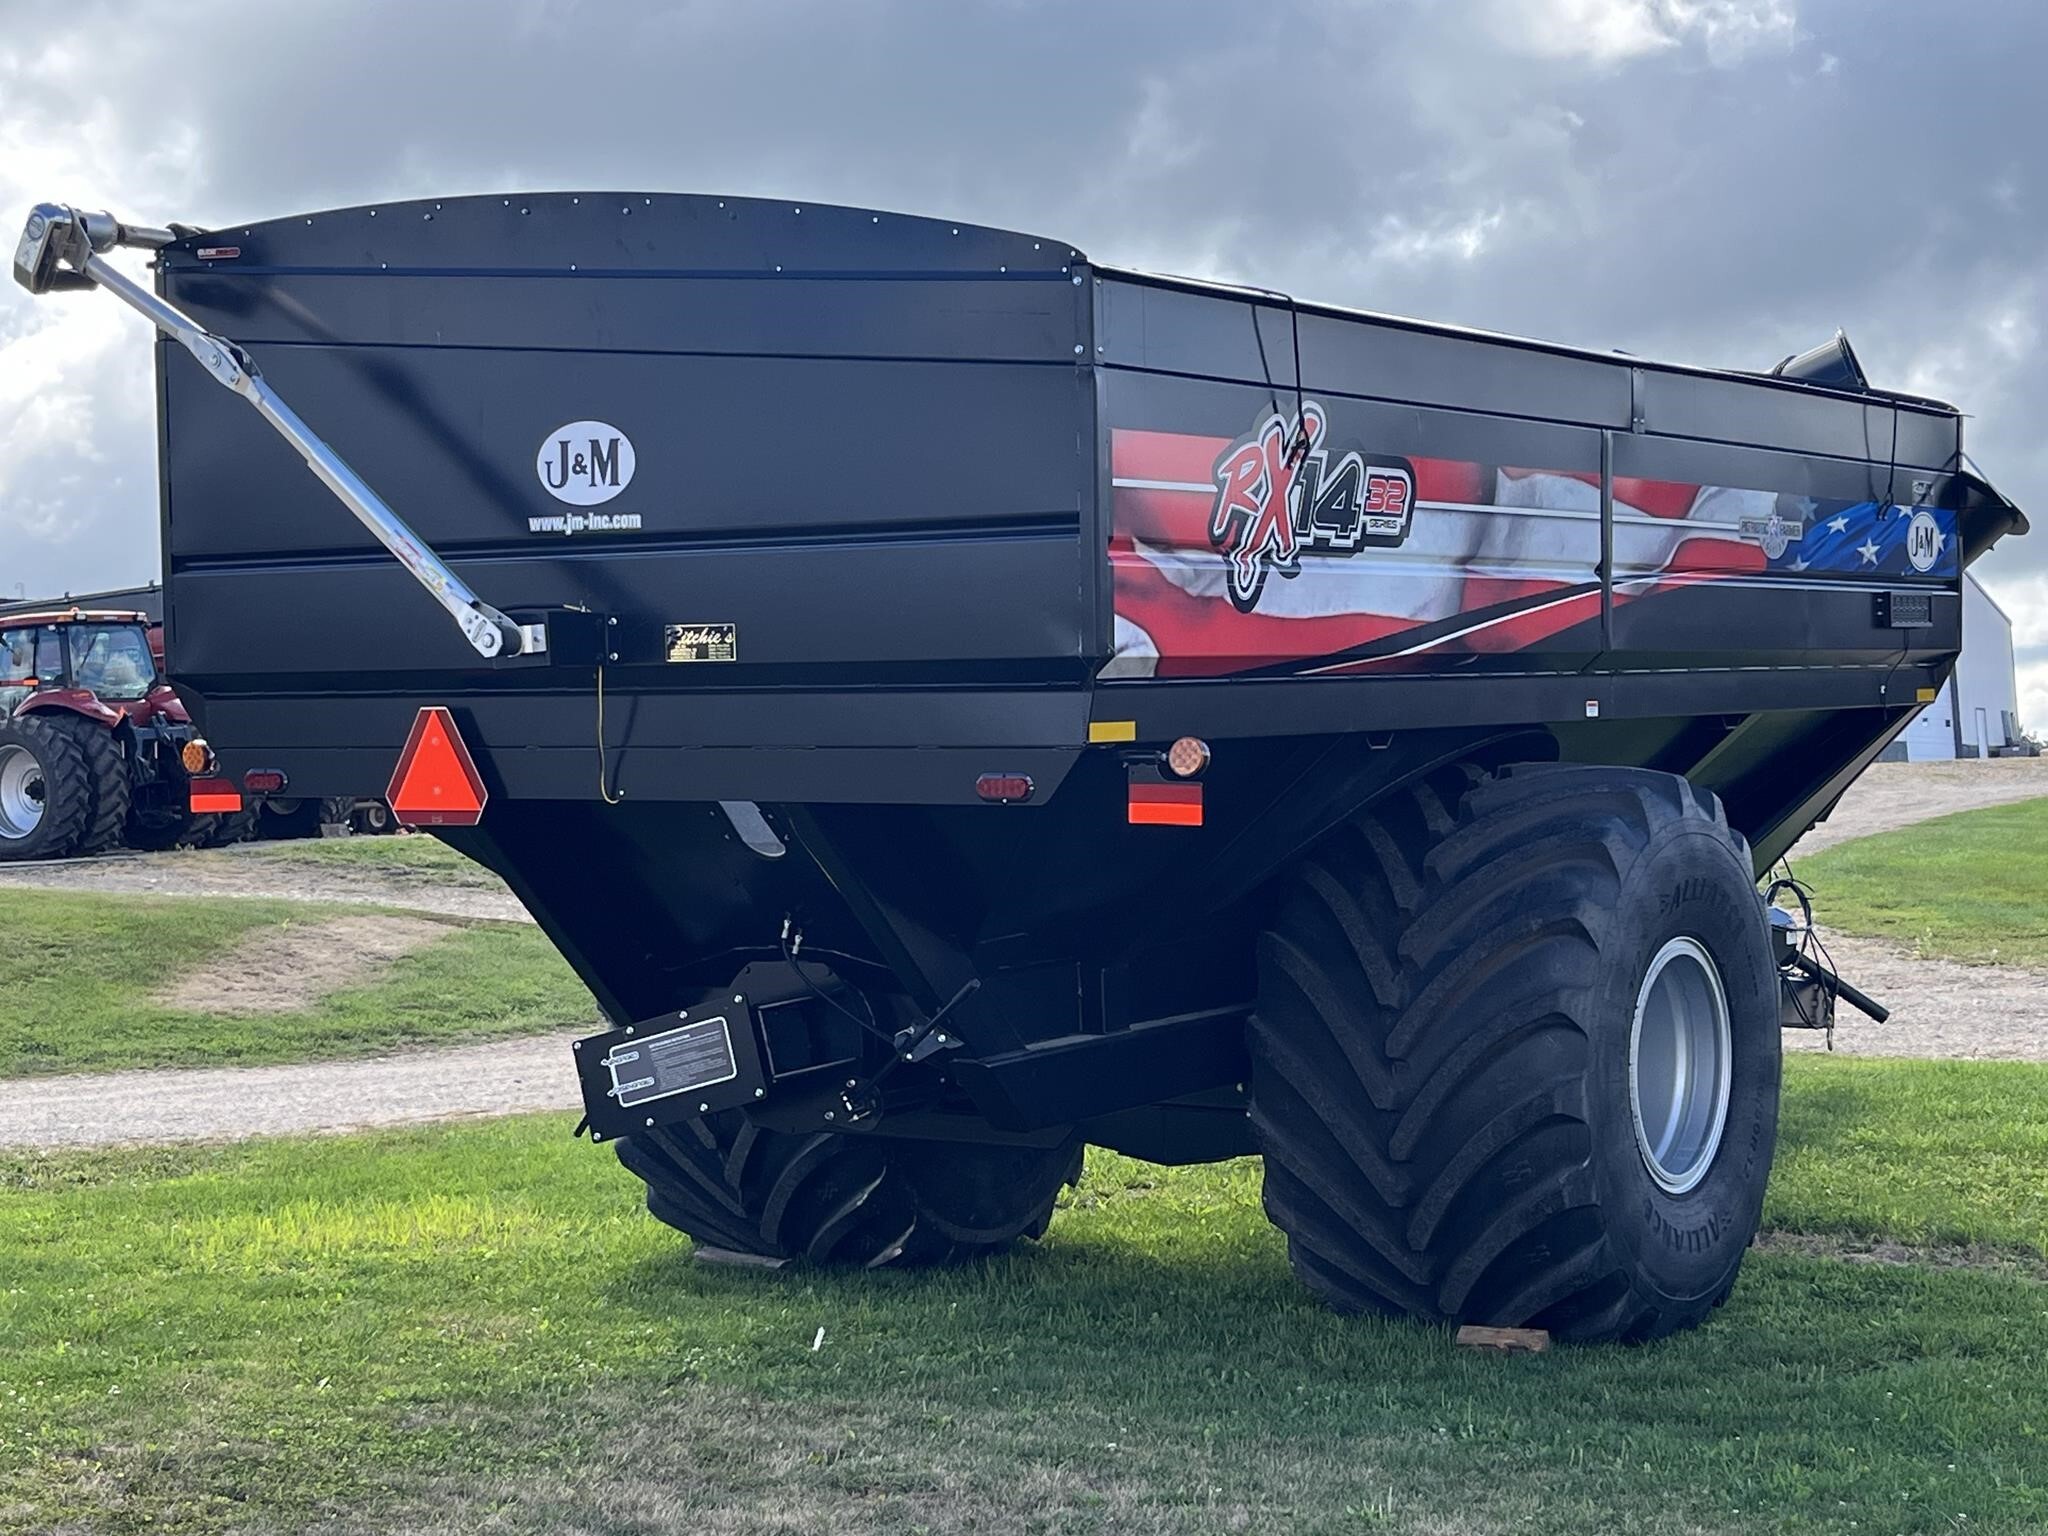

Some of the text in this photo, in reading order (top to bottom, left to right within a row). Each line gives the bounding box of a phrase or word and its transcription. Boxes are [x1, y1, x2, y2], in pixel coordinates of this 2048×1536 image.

[544, 438, 621, 489] J&M
[1365, 478, 1406, 514] 32
[1369, 518, 1398, 529] SERIES
[1911, 525, 1934, 558] J&M
